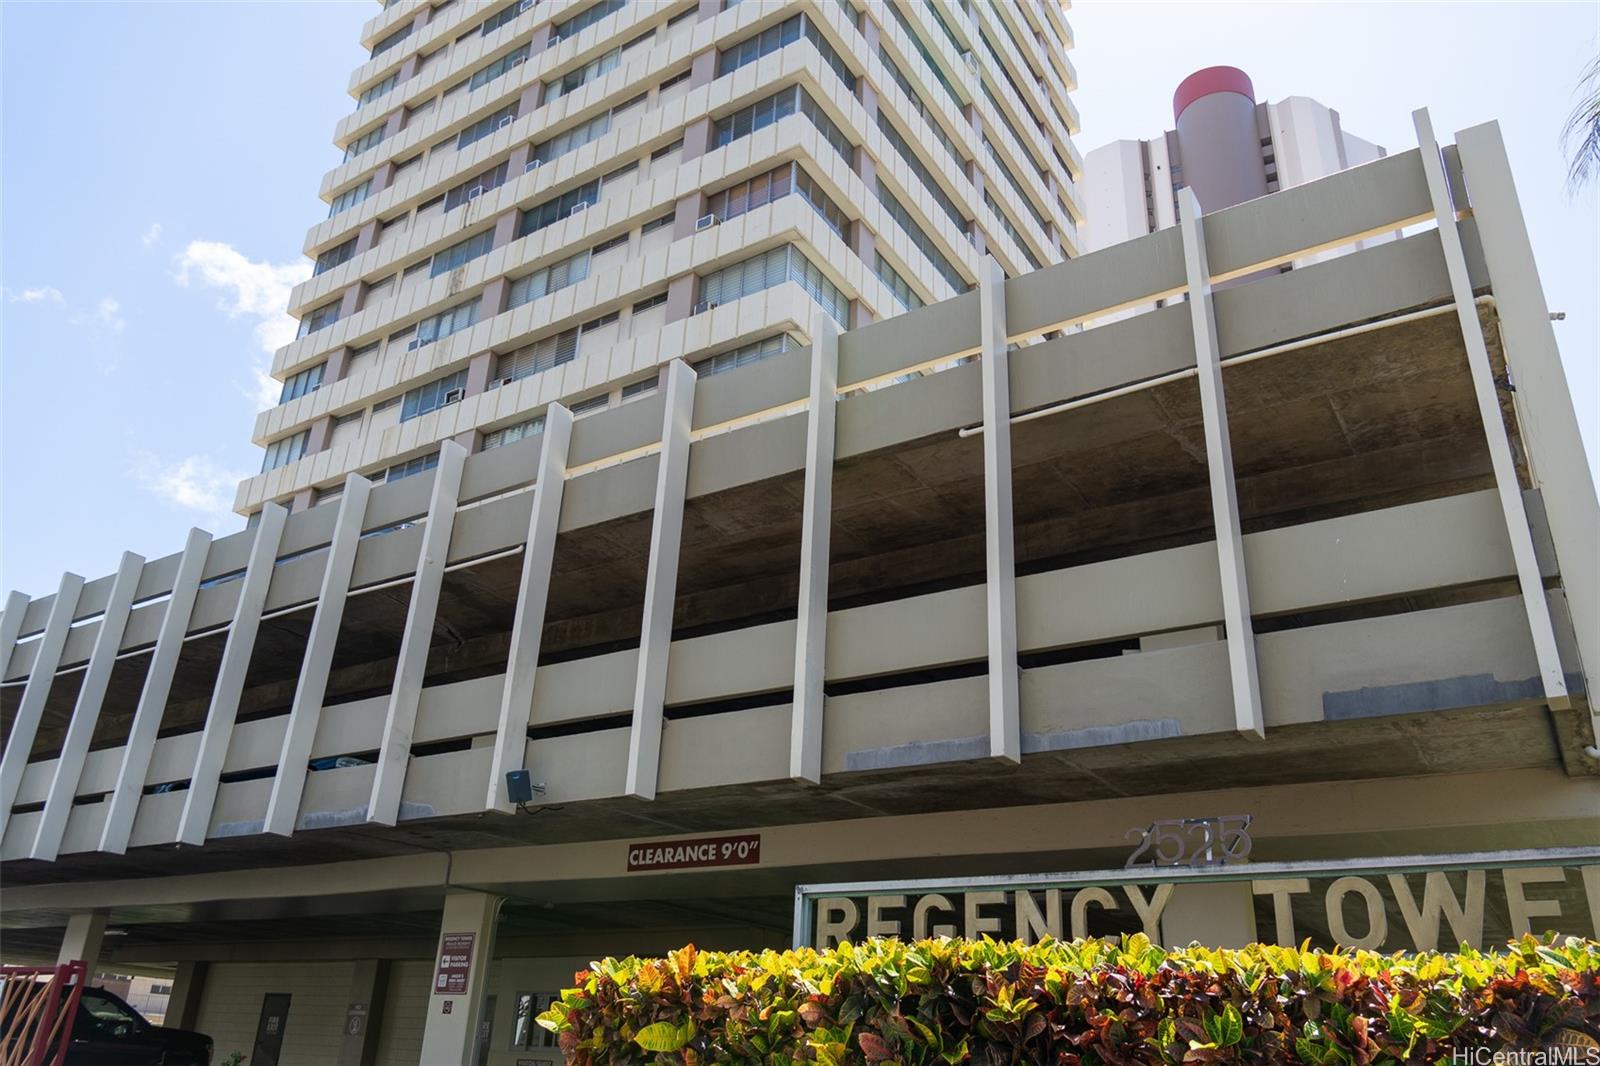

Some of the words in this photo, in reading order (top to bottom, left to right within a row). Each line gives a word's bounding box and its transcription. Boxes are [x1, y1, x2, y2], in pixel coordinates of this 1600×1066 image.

[629, 843, 717, 866] CLEARANCE
[1124, 815, 1253, 869] 2525
[816, 883, 1175, 952] REGENCY
